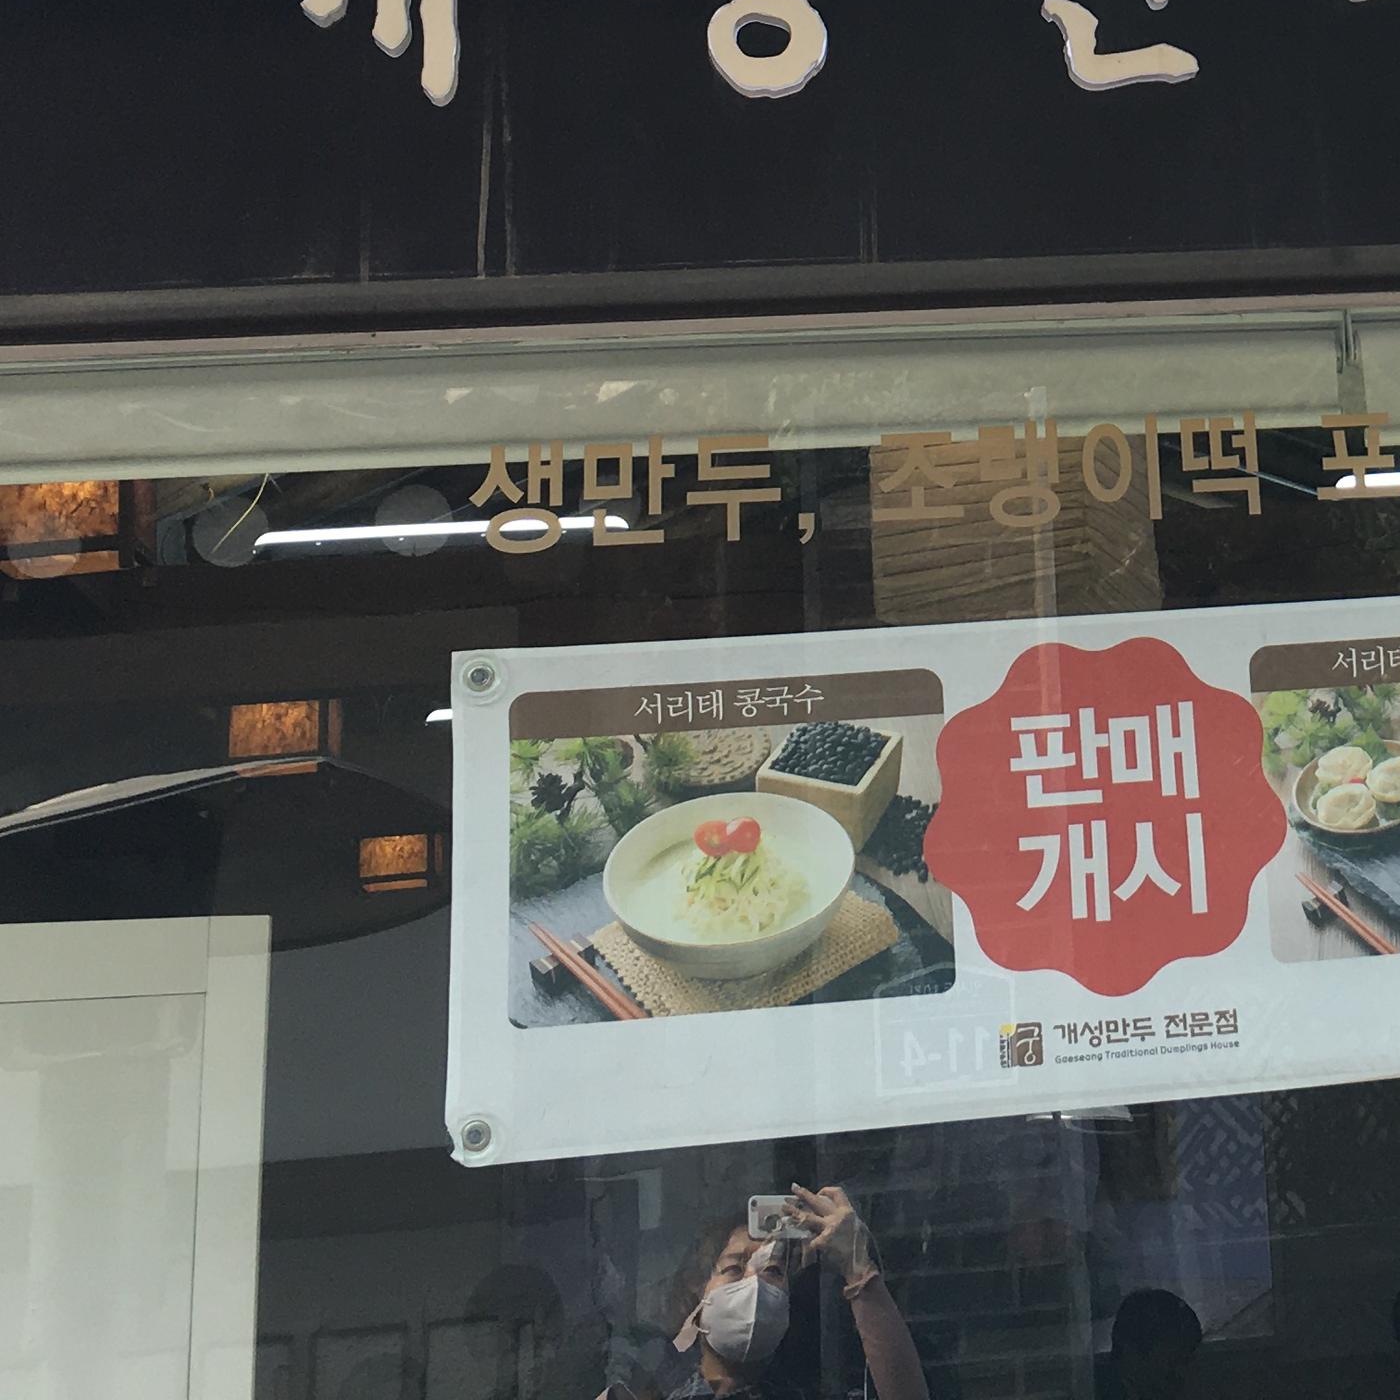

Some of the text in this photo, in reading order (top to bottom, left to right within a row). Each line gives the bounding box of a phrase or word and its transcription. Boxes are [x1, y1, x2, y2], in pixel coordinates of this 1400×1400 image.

[469, 434, 816, 554] 생만두,
[872, 409, 1262, 528] 조랭이떡
[634, 683, 825, 725] 서리태 콩국수
[1009, 700, 1201, 808] 판매
[1015, 812, 1209, 922] 개시
[1053, 1008, 1239, 1047] 개성만두 전문점
[1105, 1047, 1158, 1061] Traditional
[1160, 1043, 1208, 1056] Dumplings
[1210, 1039, 1240, 1050] House
